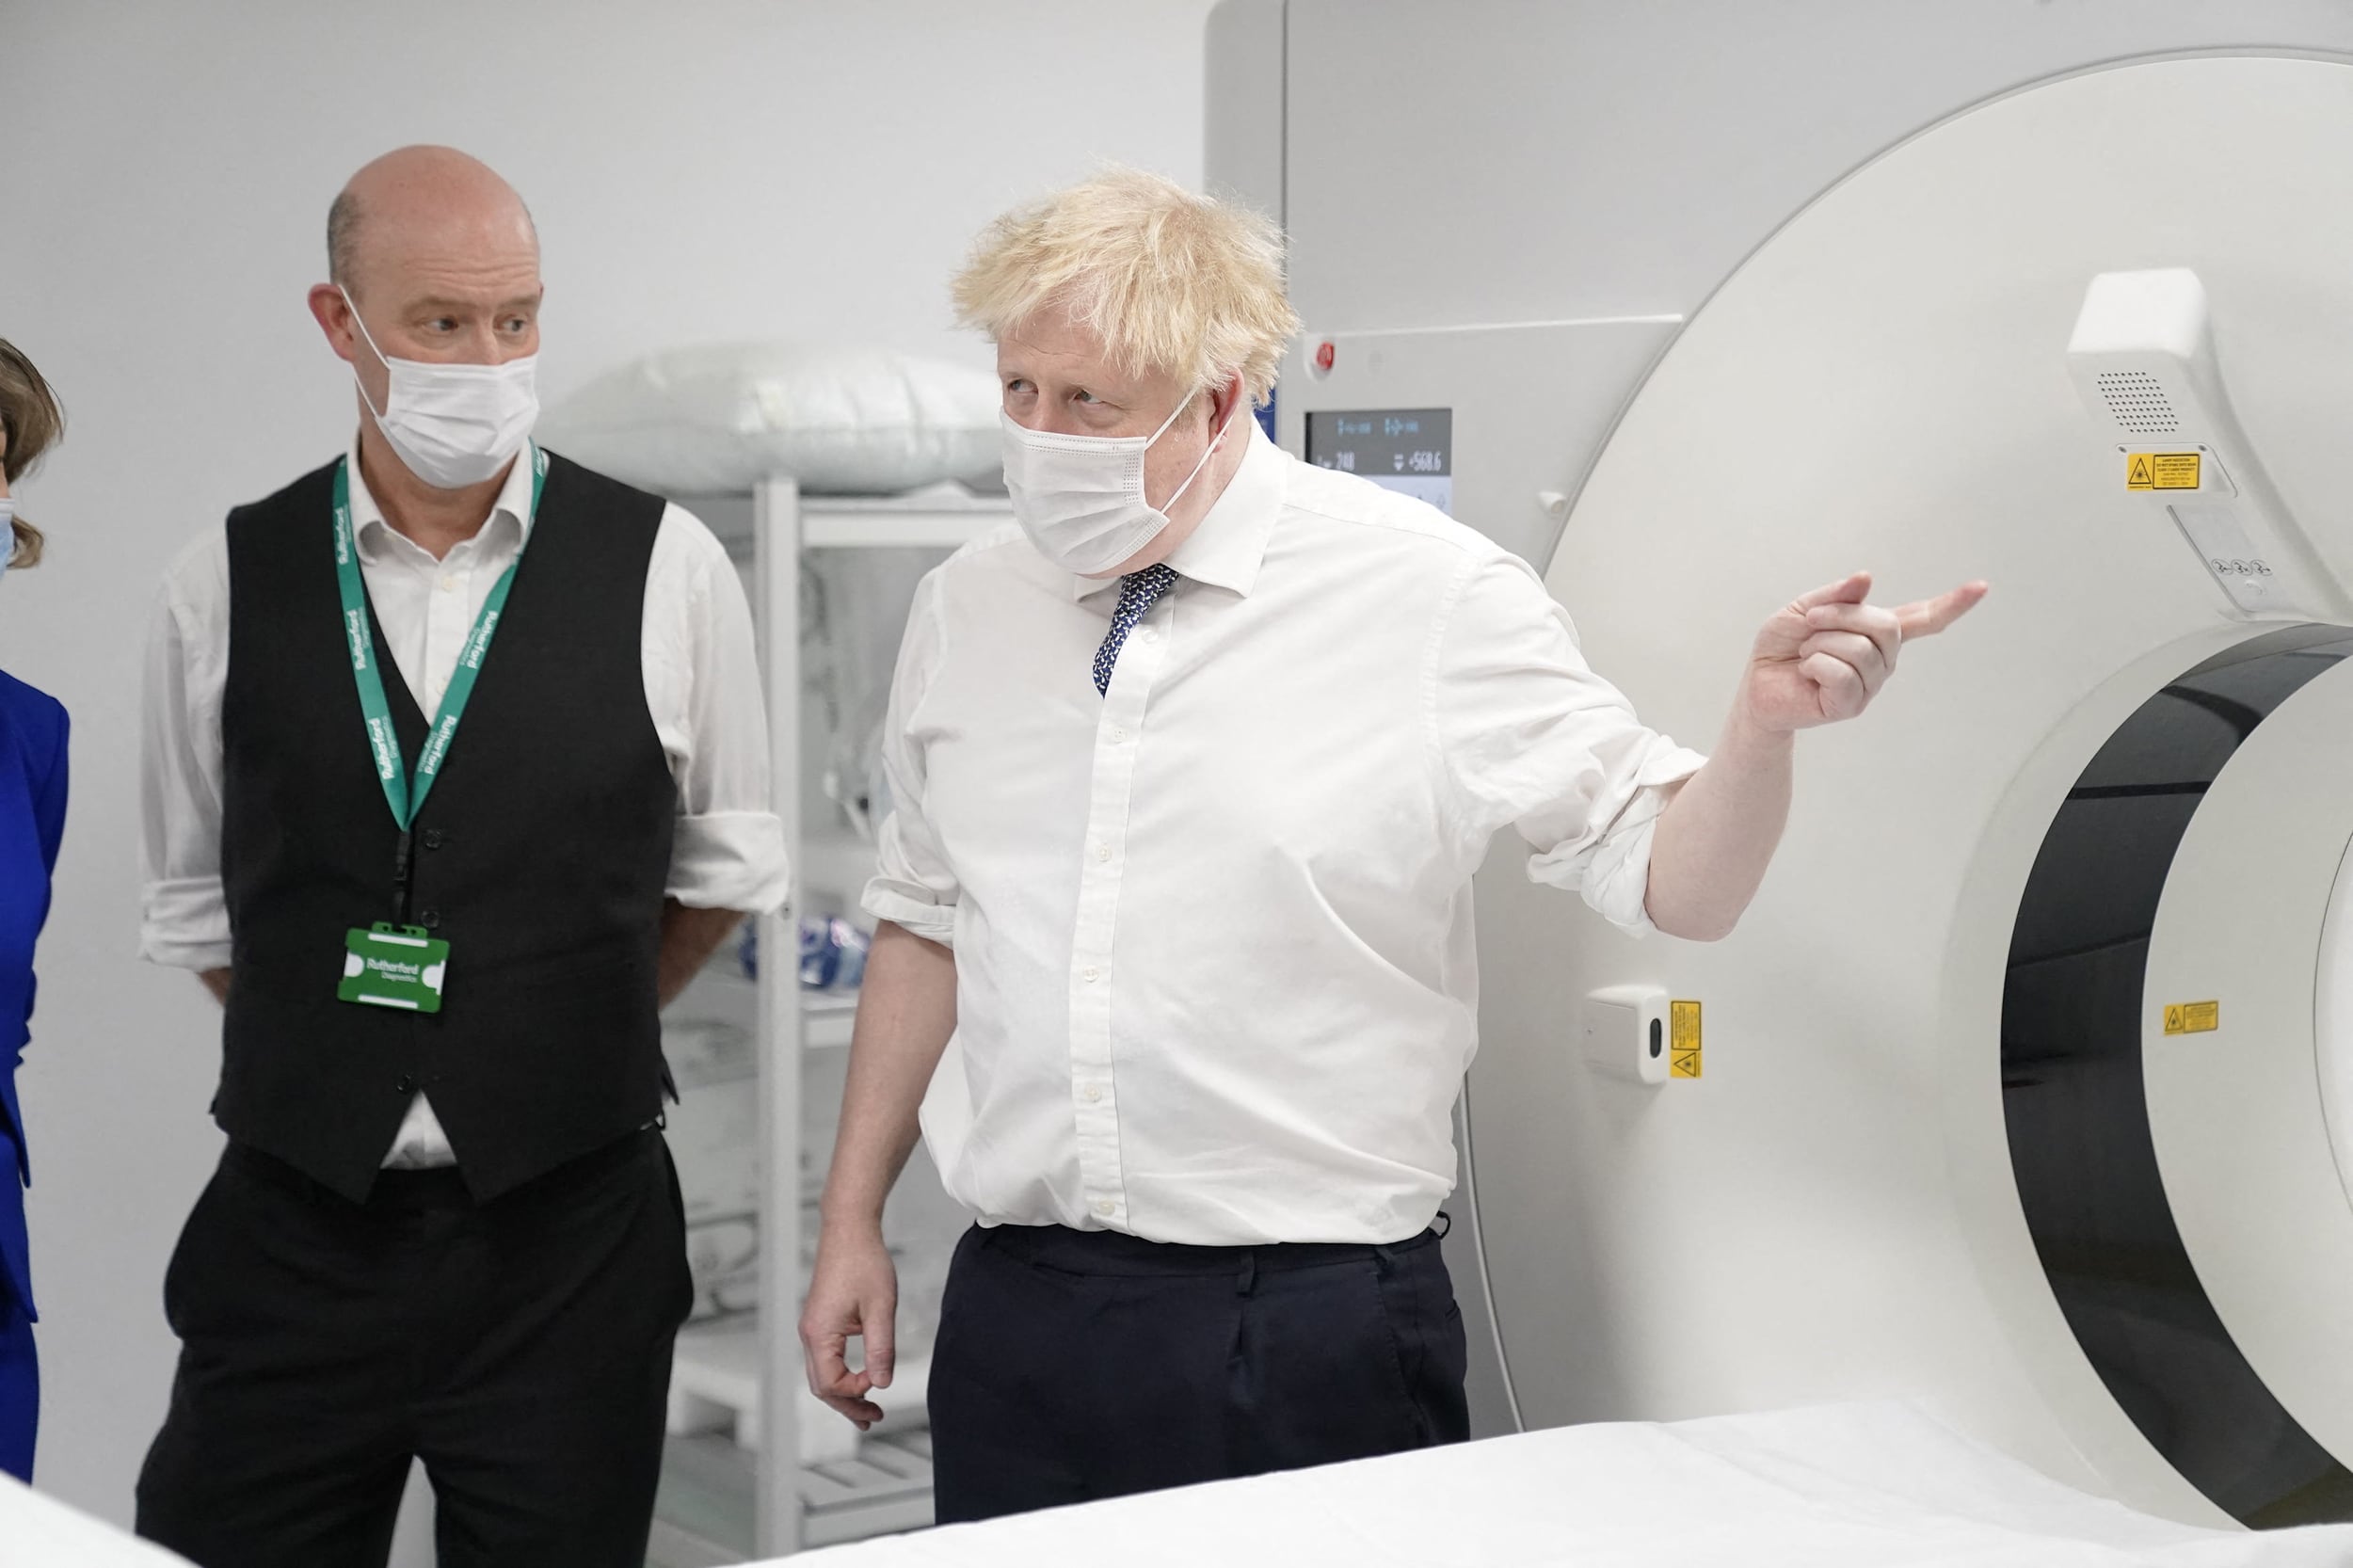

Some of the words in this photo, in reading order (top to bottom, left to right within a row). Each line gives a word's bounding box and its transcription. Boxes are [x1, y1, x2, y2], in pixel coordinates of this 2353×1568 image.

[346, 610, 367, 670] Rutherford
[466, 611, 498, 669] Rutherford
[368, 717, 394, 780] Rutherford
[424, 714, 457, 776] Rutherford
[367, 957, 420, 975] Rutherford
